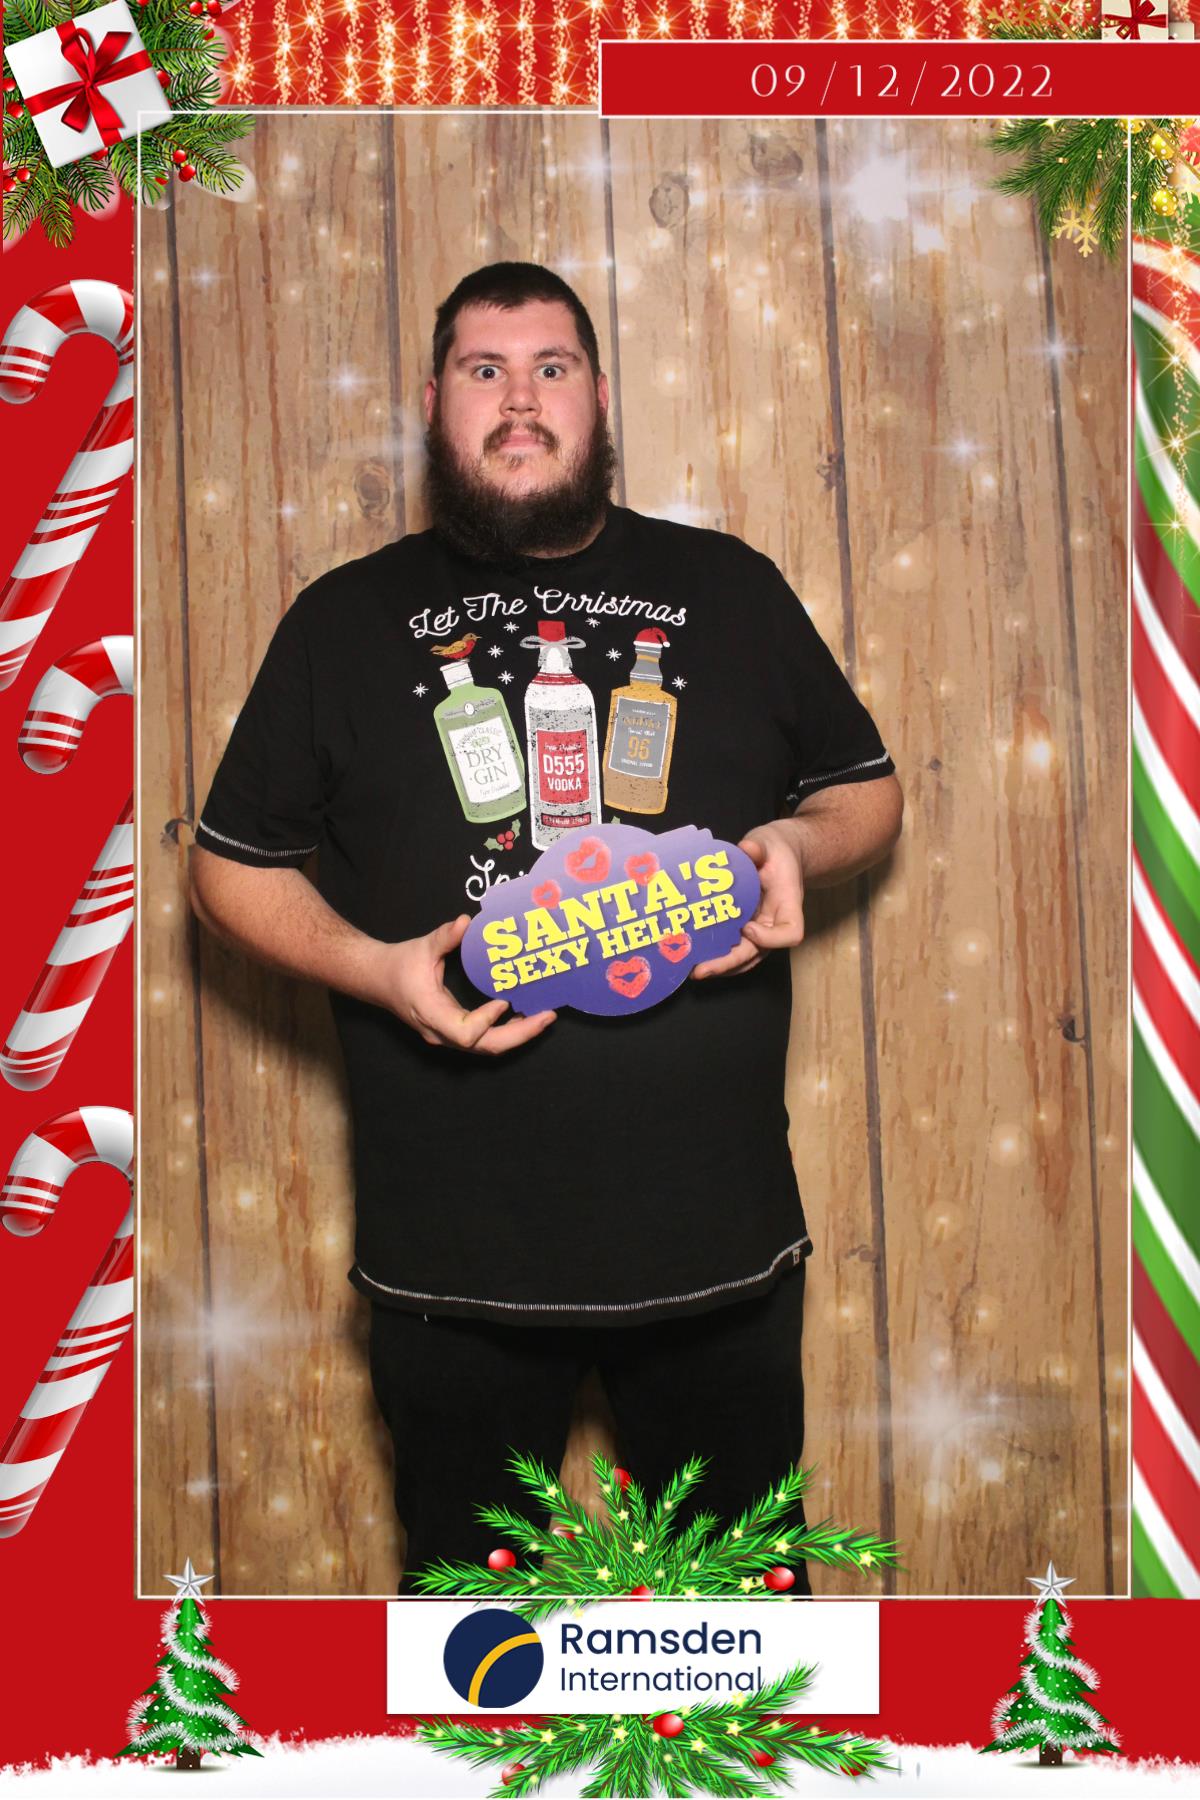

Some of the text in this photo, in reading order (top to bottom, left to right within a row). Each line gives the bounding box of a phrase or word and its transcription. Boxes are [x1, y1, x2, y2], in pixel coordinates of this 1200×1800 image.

[409, 585, 687, 639] Let The Christmas
[466, 743, 502, 768] DRY
[627, 735, 652, 760] 96
[474, 762, 508, 785] GIN
[542, 753, 585, 776] D555
[547, 777, 583, 792] VODKA
[482, 850, 735, 964] SANTA'S
[490, 893, 742, 993] SEXY HELPER
